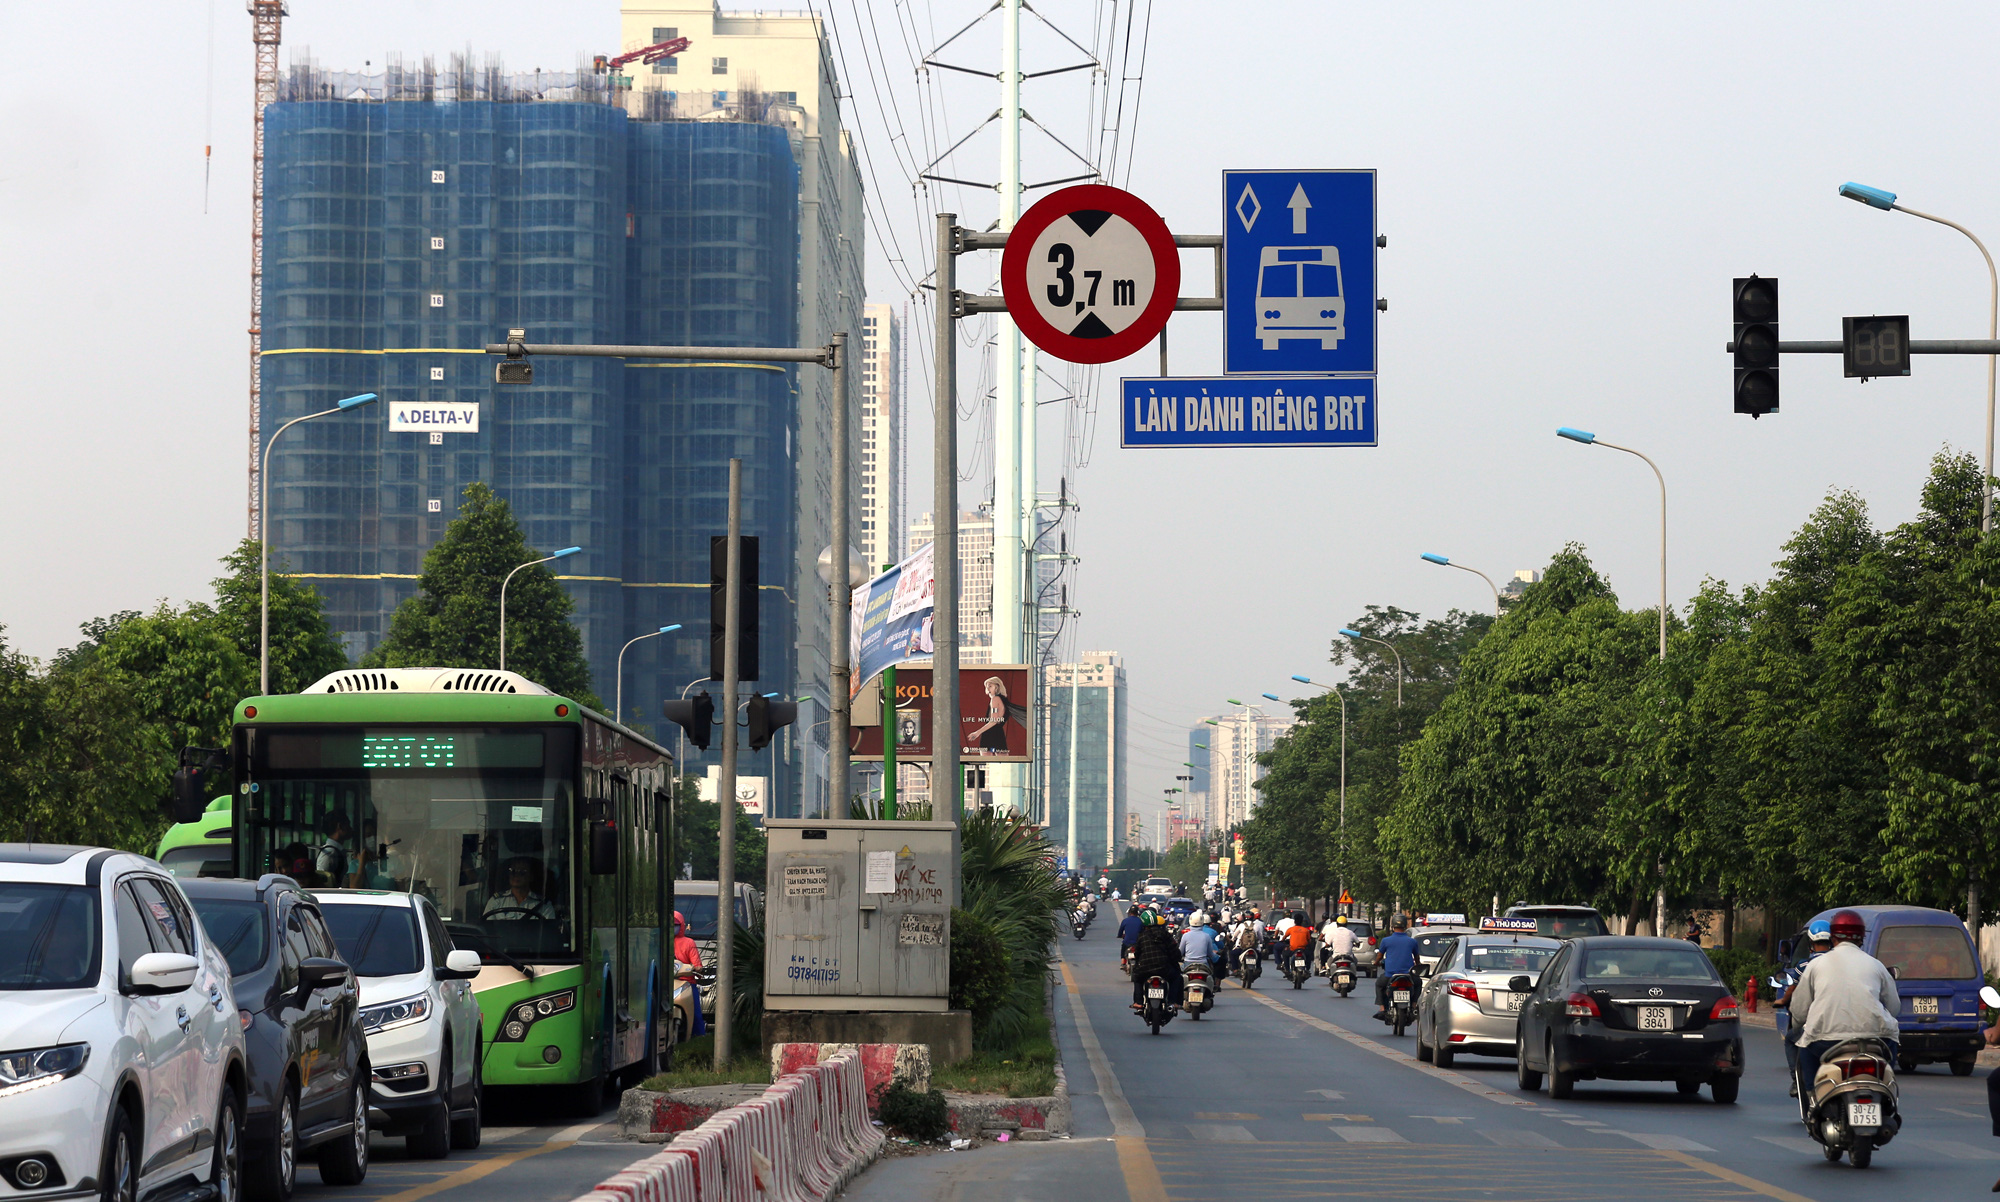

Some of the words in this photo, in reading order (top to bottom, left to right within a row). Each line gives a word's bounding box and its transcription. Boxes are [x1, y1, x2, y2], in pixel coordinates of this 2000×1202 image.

[433, 173, 443, 181] 20
[432, 240, 443, 248] 18
[1047, 243, 1102, 317] 3,7
[1113, 277, 1136, 306] m
[432, 296, 442, 305] 16
[432, 370, 442, 378] 14
[1134, 388, 1178, 432] LÀN
[1184, 388, 1245, 432] DÀNH
[1251, 388, 1317, 432] RIÊNG
[1324, 396, 1366, 432] BRT
[411, 409, 474, 424] DELTA-V
[431, 434, 441, 443] 12
[430, 502, 439, 510] 10
[896, 685, 934, 698] KOL
[918, 869, 937, 885] XE
[1495, 919, 1510, 928] THỦ
[1510, 920, 1520, 929] ĐÔ
[1521, 921, 1536, 929] SAO
[787, 965, 841, 982] 0978417195
[1646, 1007, 1665, 1018] 30S
[1644, 1018, 1668, 1029] 3841
[1853, 1115, 1877, 1124] 0755
